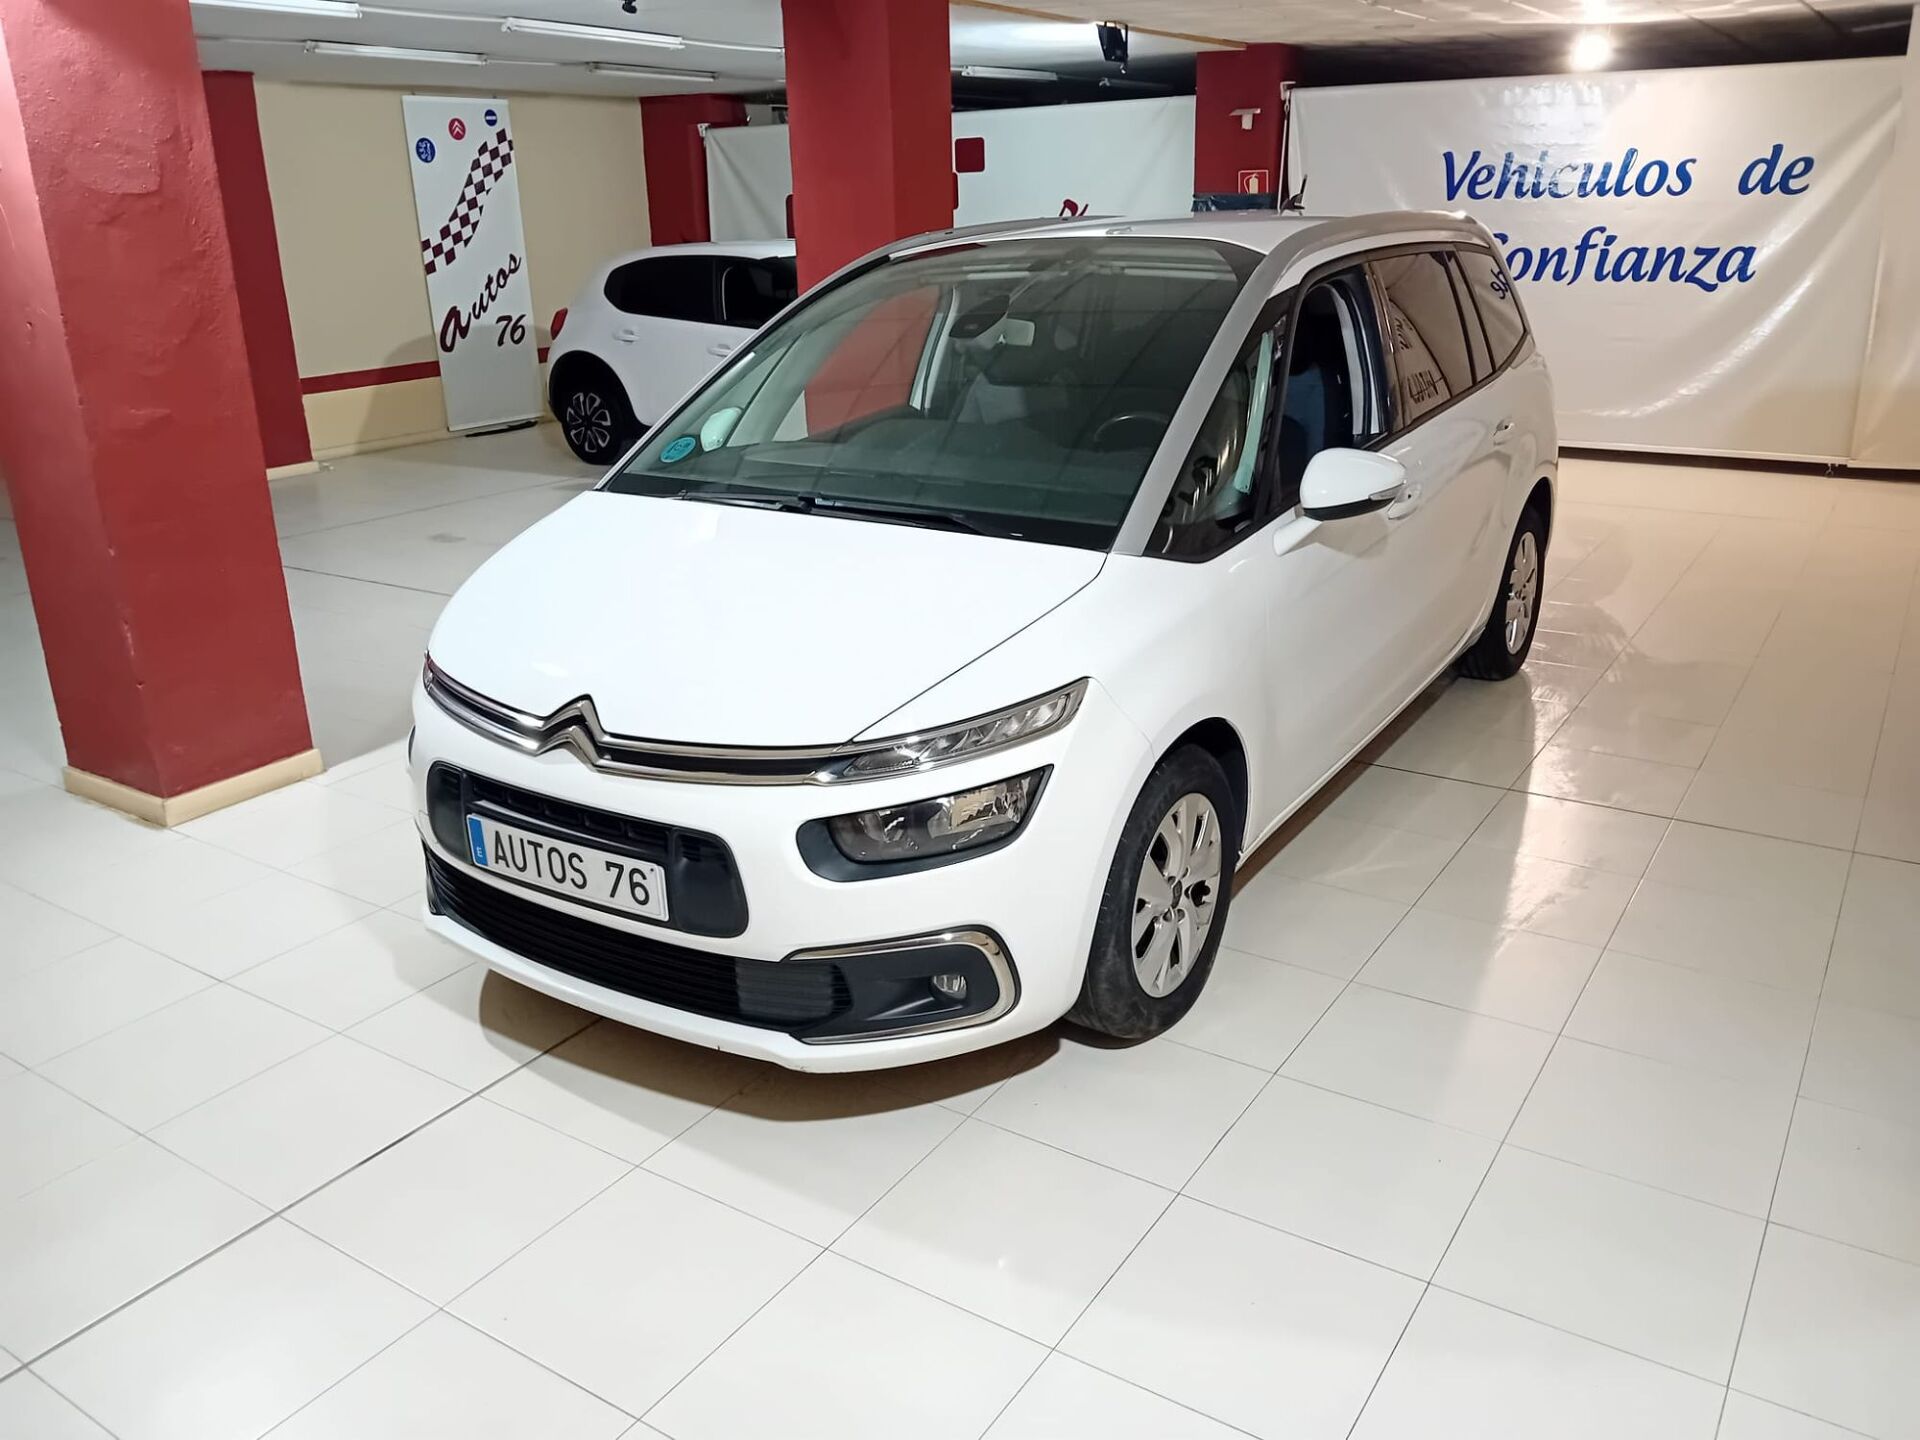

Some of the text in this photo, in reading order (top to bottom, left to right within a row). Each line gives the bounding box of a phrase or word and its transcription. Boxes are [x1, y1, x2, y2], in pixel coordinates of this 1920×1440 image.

[1738, 143, 1815, 196] de
[1492, 226, 1757, 292] onfianza
[439, 253, 521, 353] Autos
[495, 314, 527, 347] 76
[494, 830, 588, 890] AUTOS
[605, 860, 650, 906] 76
